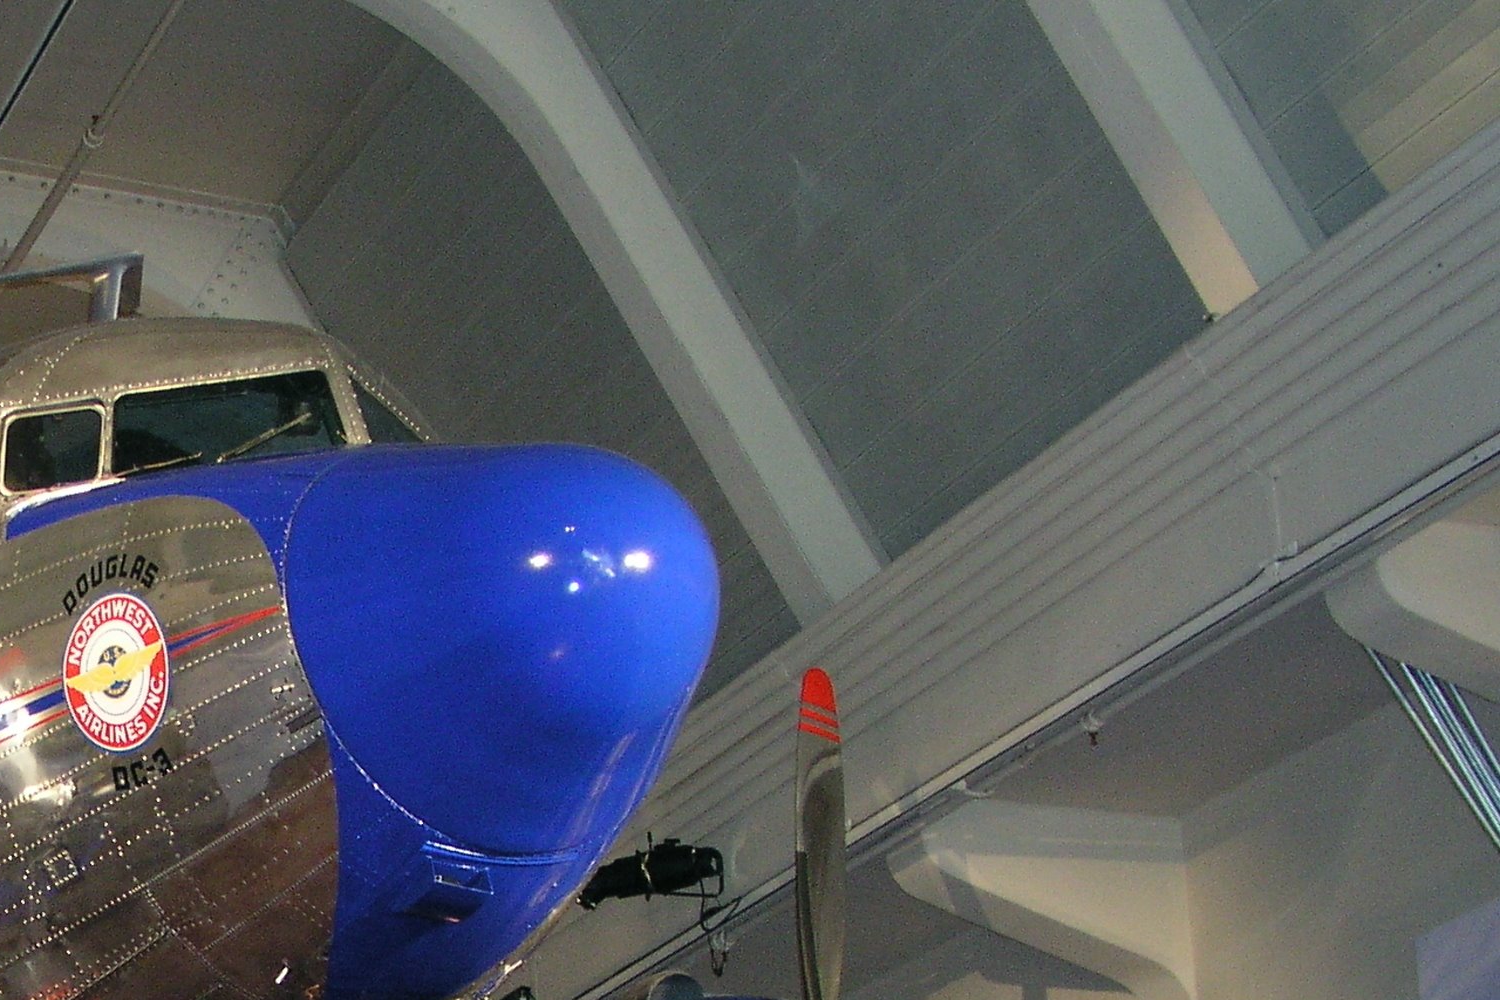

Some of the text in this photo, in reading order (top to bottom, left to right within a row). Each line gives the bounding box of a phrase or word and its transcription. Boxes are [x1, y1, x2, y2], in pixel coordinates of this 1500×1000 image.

[62, 553, 159, 616] DOUGLAS
[68, 597, 154, 666] NORTHWEST
[75, 670, 165, 744] AIRLINES INC.
[112, 747, 173, 791] DC-3
